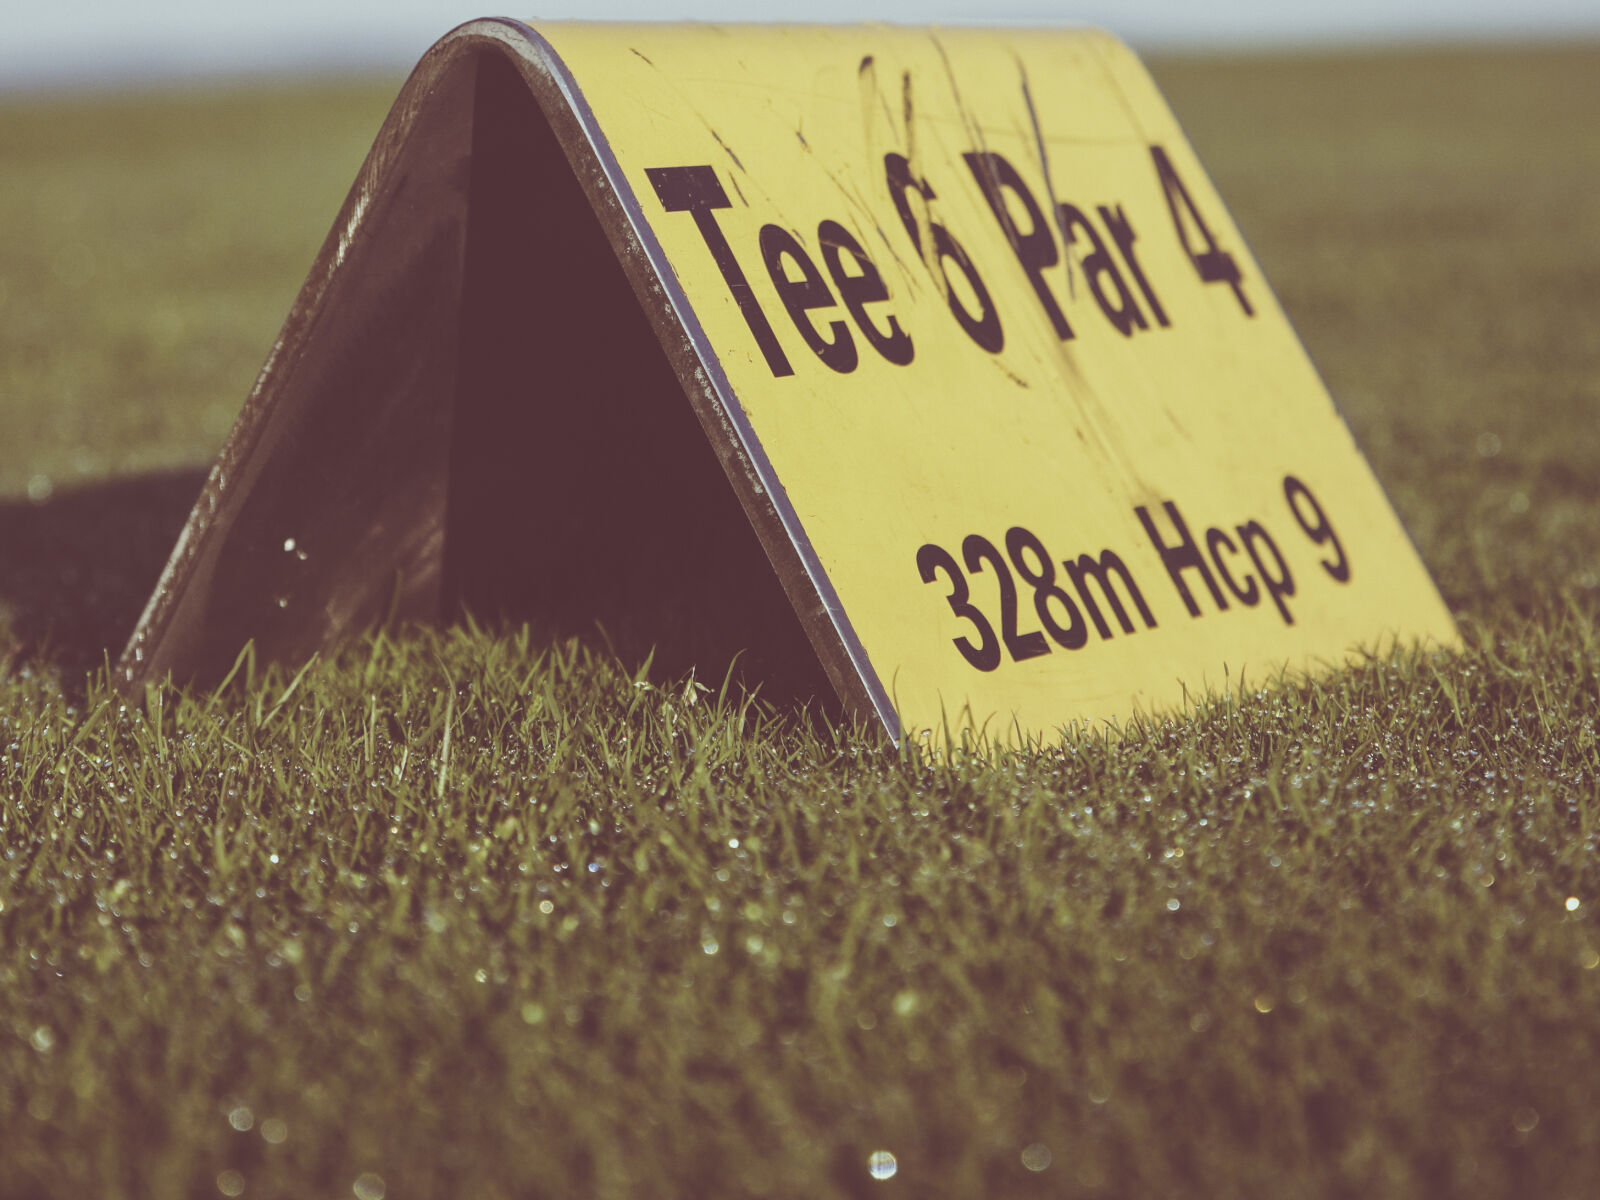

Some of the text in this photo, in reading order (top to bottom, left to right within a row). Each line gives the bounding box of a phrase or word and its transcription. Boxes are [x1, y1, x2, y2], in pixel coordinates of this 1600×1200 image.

[644, 143, 1256, 378] Tee 6 Par 4
[915, 474, 1353, 673] 328m Hcp 9
